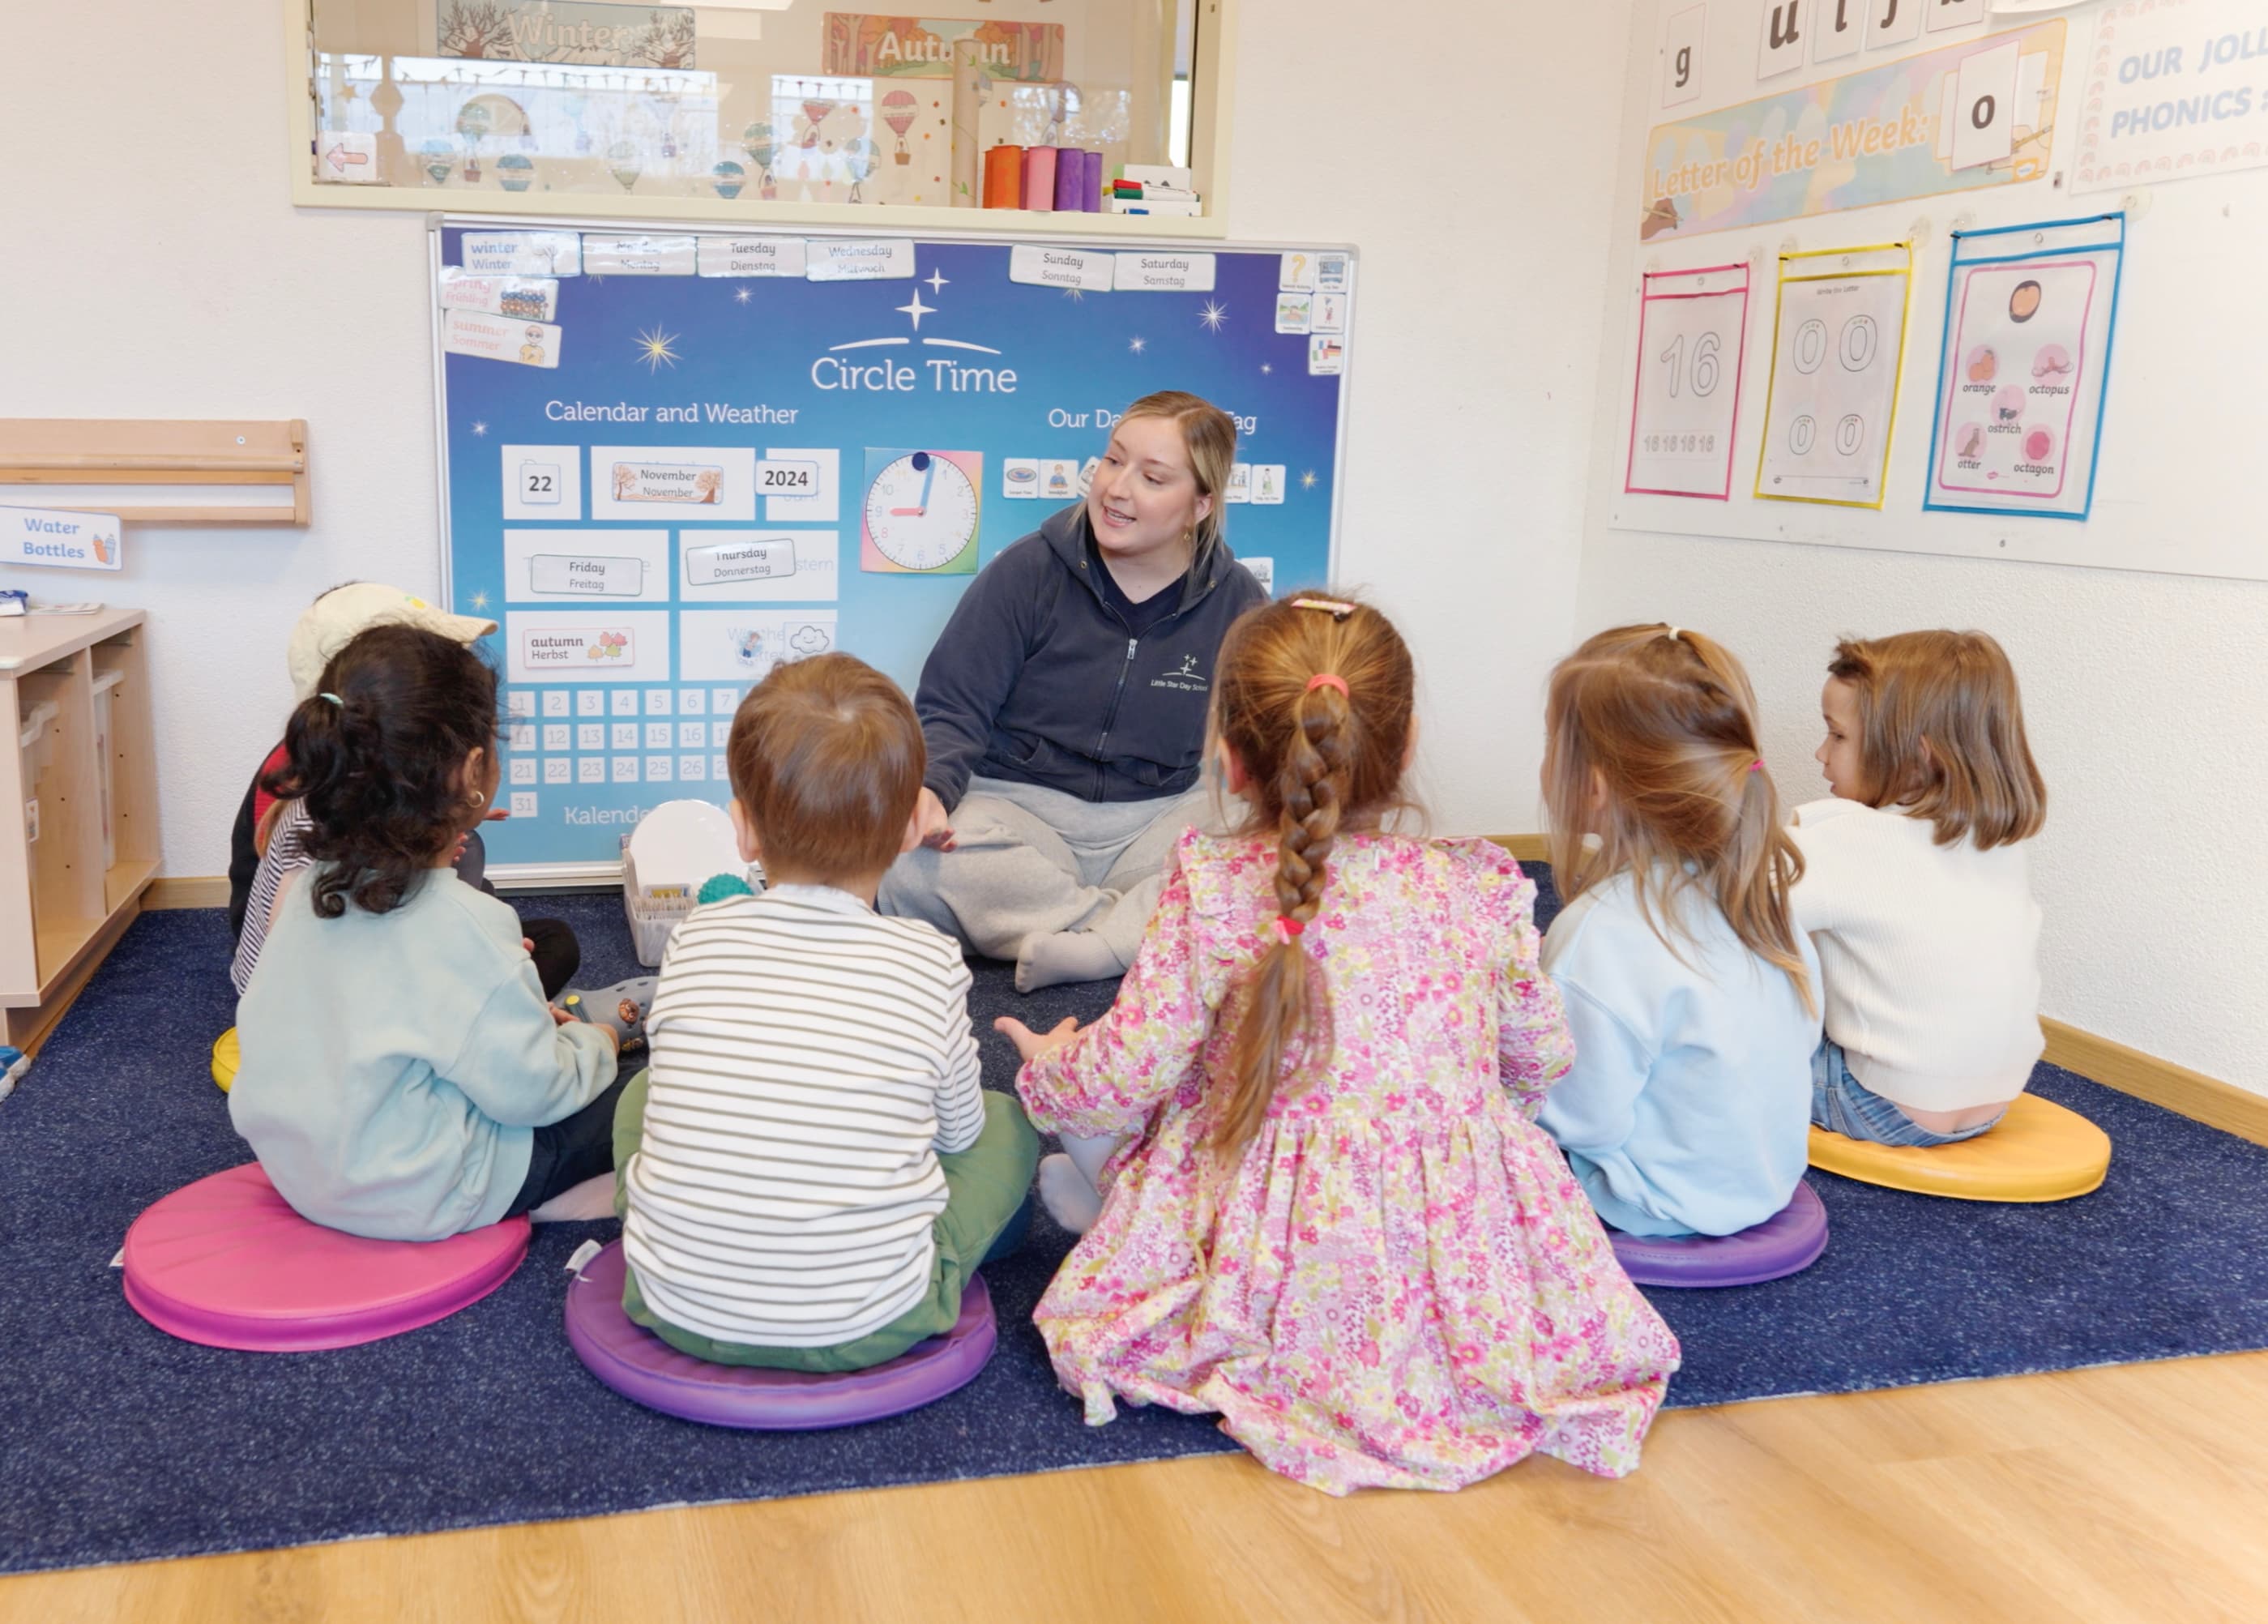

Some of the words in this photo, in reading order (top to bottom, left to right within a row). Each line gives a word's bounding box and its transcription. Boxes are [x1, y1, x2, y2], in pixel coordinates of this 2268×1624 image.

[506, 13, 630, 47] Winter
[878, 31, 1010, 65] Autun
[1675, 45, 1691, 88] g
[2118, 46, 2183, 84] OUR
[2111, 86, 2253, 139] PHONICS
[1652, 159, 1728, 199] Letter
[1735, 139, 1767, 190] of
[1772, 133, 1821, 173] the
[1830, 106, 1928, 161] Week:
[471, 241, 519, 254] winter
[731, 243, 776, 256] Tuesday
[829, 246, 892, 258] Wednesday
[472, 259, 512, 270] Winter
[731, 261, 775, 272] Dienstag
[1043, 253, 1084, 270] Sunday
[1141, 259, 1190, 271] Saturday
[1042, 271, 1082, 286] Sonntag
[1143, 276, 1186, 288] Samstag
[1660, 331, 1721, 398] 16
[811, 357, 916, 391] Circle
[926, 359, 1018, 393] Time
[1963, 384, 1996, 395] orange
[2029, 385, 2069, 397] octopus
[545, 400, 650, 422] Calendar
[656, 402, 700, 423] and
[704, 403, 799, 425] Weather
[1049, 408, 1090, 429] Our
[1096, 409, 1121, 429] Da
[1988, 424, 2022, 434] ostrich
[1958, 459, 1981, 469] otter
[2014, 464, 2054, 477] octagon
[641, 469, 696, 481] November
[765, 470, 809, 486] 2024
[529, 476, 552, 492] 22
[643, 487, 694, 498] November
[875, 506, 882, 517] 9
[24, 518, 80, 535] Water
[882, 528, 888, 538] 8
[23, 541, 85, 558] Bottles
[570, 562, 605, 575] Friday
[714, 564, 771, 578] Donnerstag
[570, 579, 604, 592] Freitag
[531, 637, 583, 647] autumn
[532, 649, 569, 660] Herbst
[1151, 679, 1166, 687] Little
[1167, 680, 1178, 688] Star
[519, 698, 526, 711] 1
[552, 696, 562, 710] 2
[586, 695, 596, 710] 3
[620, 696, 630, 709] 4
[654, 695, 664, 709] 5
[688, 694, 697, 708] 6
[720, 694, 730, 707] 7
[549, 730, 566, 744] 12
[583, 729, 600, 744] 13
[617, 729, 634, 742] 14
[651, 729, 668, 742] 15
[685, 728, 702, 741] 16
[515, 764, 532, 778] 21
[548, 763, 567, 778] 22
[583, 763, 601, 777] 23
[616, 762, 635, 776] 24
[649, 762, 668, 776] 25
[683, 761, 703, 775] 26
[515, 797, 532, 811] 31
[563, 805, 649, 825] Kalende
